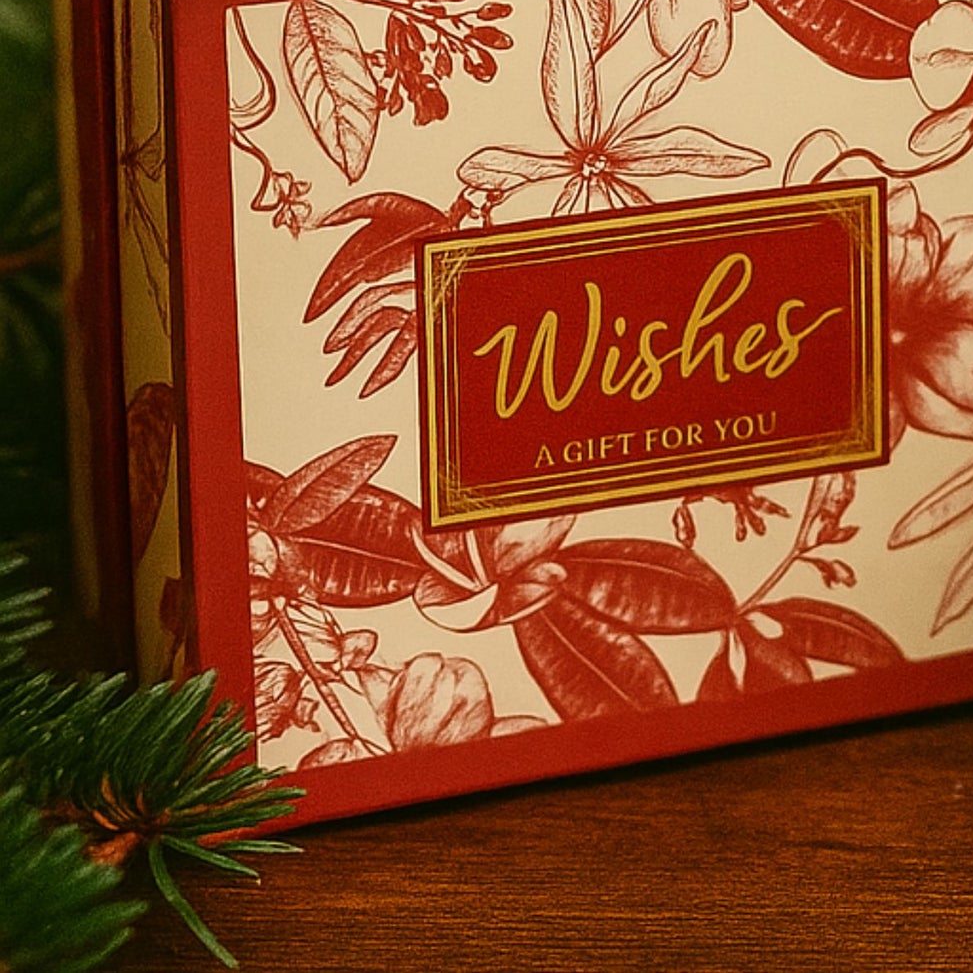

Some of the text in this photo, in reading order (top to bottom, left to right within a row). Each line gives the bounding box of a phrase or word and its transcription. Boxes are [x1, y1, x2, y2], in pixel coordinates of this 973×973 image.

[473, 252, 844, 419] Wishes
[534, 411, 779, 468] A GIFT FOR YOU
